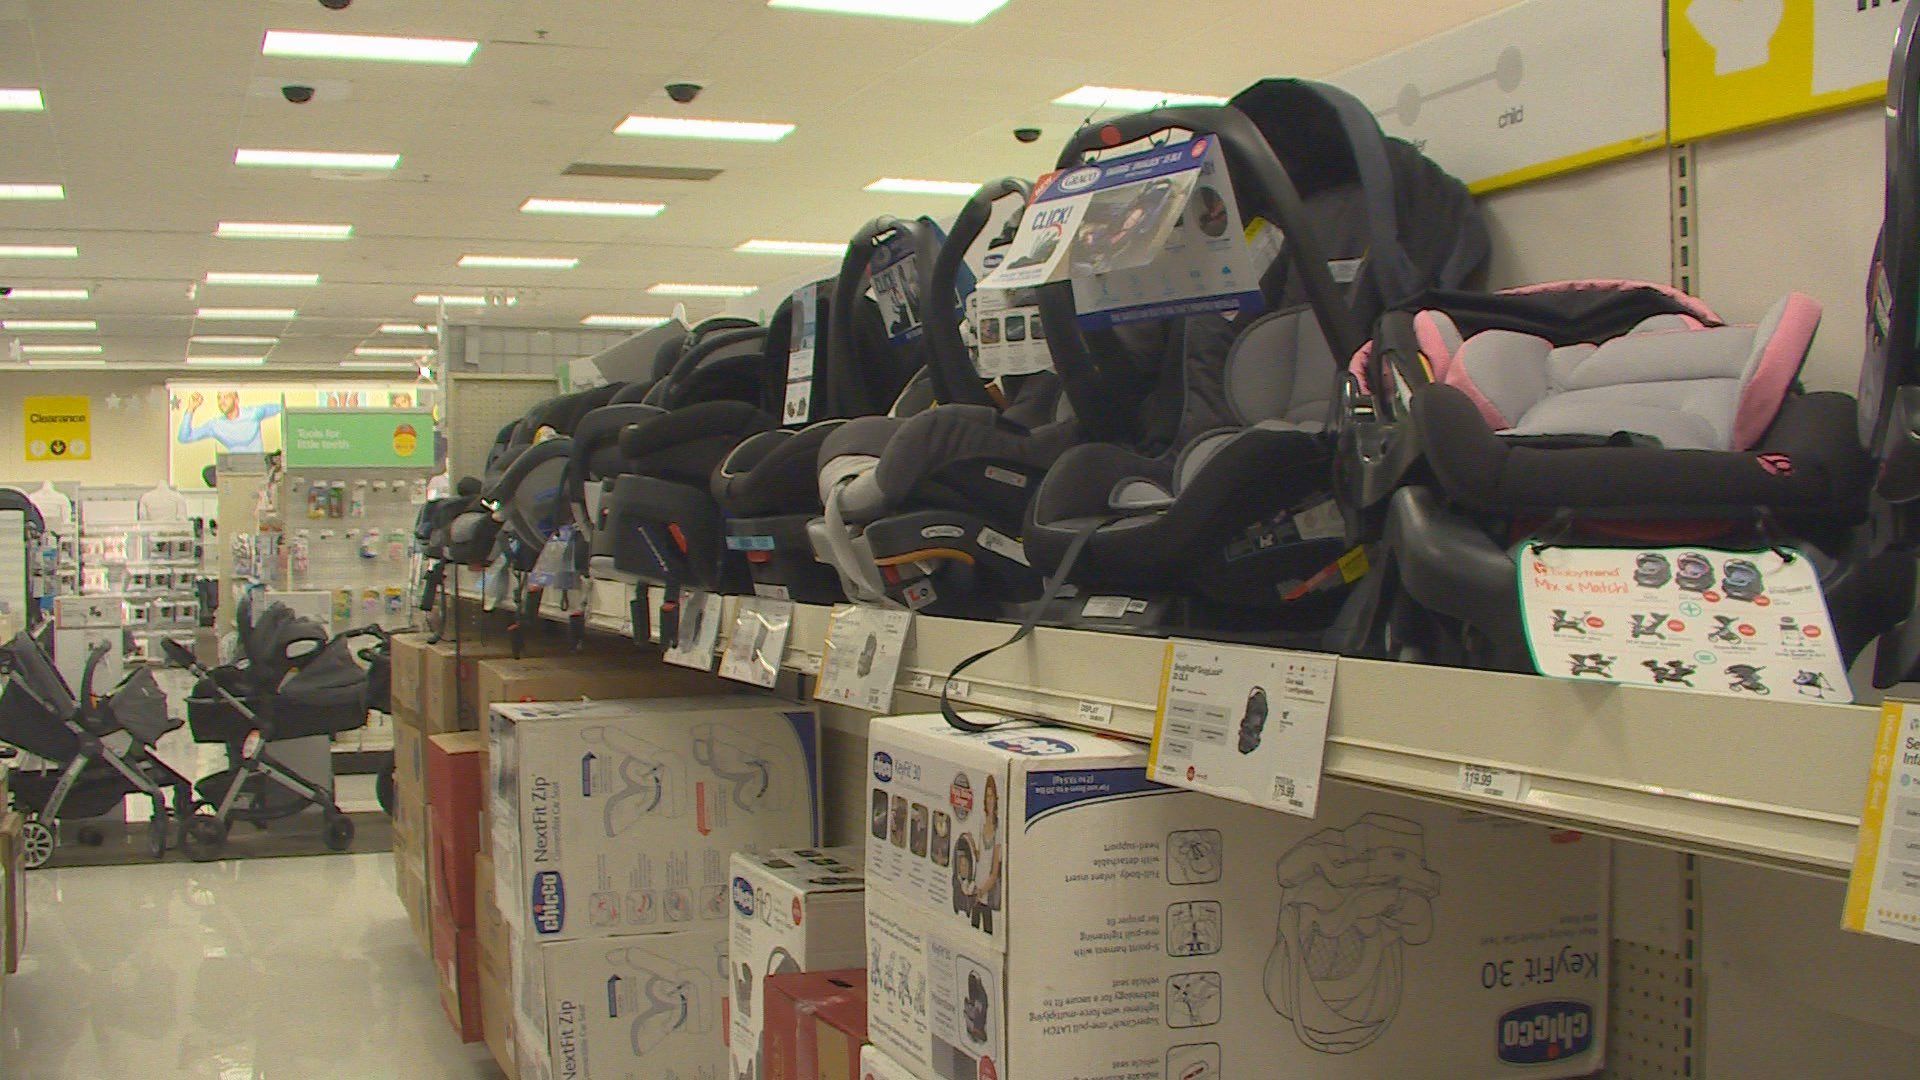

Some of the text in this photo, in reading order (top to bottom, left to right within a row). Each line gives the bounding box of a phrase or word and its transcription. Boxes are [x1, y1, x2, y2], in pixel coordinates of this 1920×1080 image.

[1498, 105, 1524, 129] child
[1031, 205, 1074, 231] CLICK!
[30, 413, 86, 423] Clearance
[298, 428, 340, 438] Tools for
[297, 439, 350, 449] little teeth
[1534, 577, 1560, 593] Mix
[1578, 582, 1629, 594] Match!
[1464, 771, 1492, 786] 119.99
[1104, 841, 1160, 852] head-support
[530, 776, 559, 931] chicco NextFit Zip
[1093, 856, 1160, 867] with detachable
[1065, 874, 1088, 883] insert
[1091, 873, 1115, 881] infant
[1074, 948, 1093, 957] with
[1481, 945, 1598, 989] KeyFit 30
[1112, 980, 1129, 988] seat
[557, 1000, 576, 1025] Zip
[1029, 1009, 1100, 1022] force-multiplying
[1102, 1007, 1120, 1016] with
[1042, 1024, 1071, 1035] LATCH
[1073, 1021, 1107, 1033] one-pull
[1503, 1011, 1588, 1059] chicco
